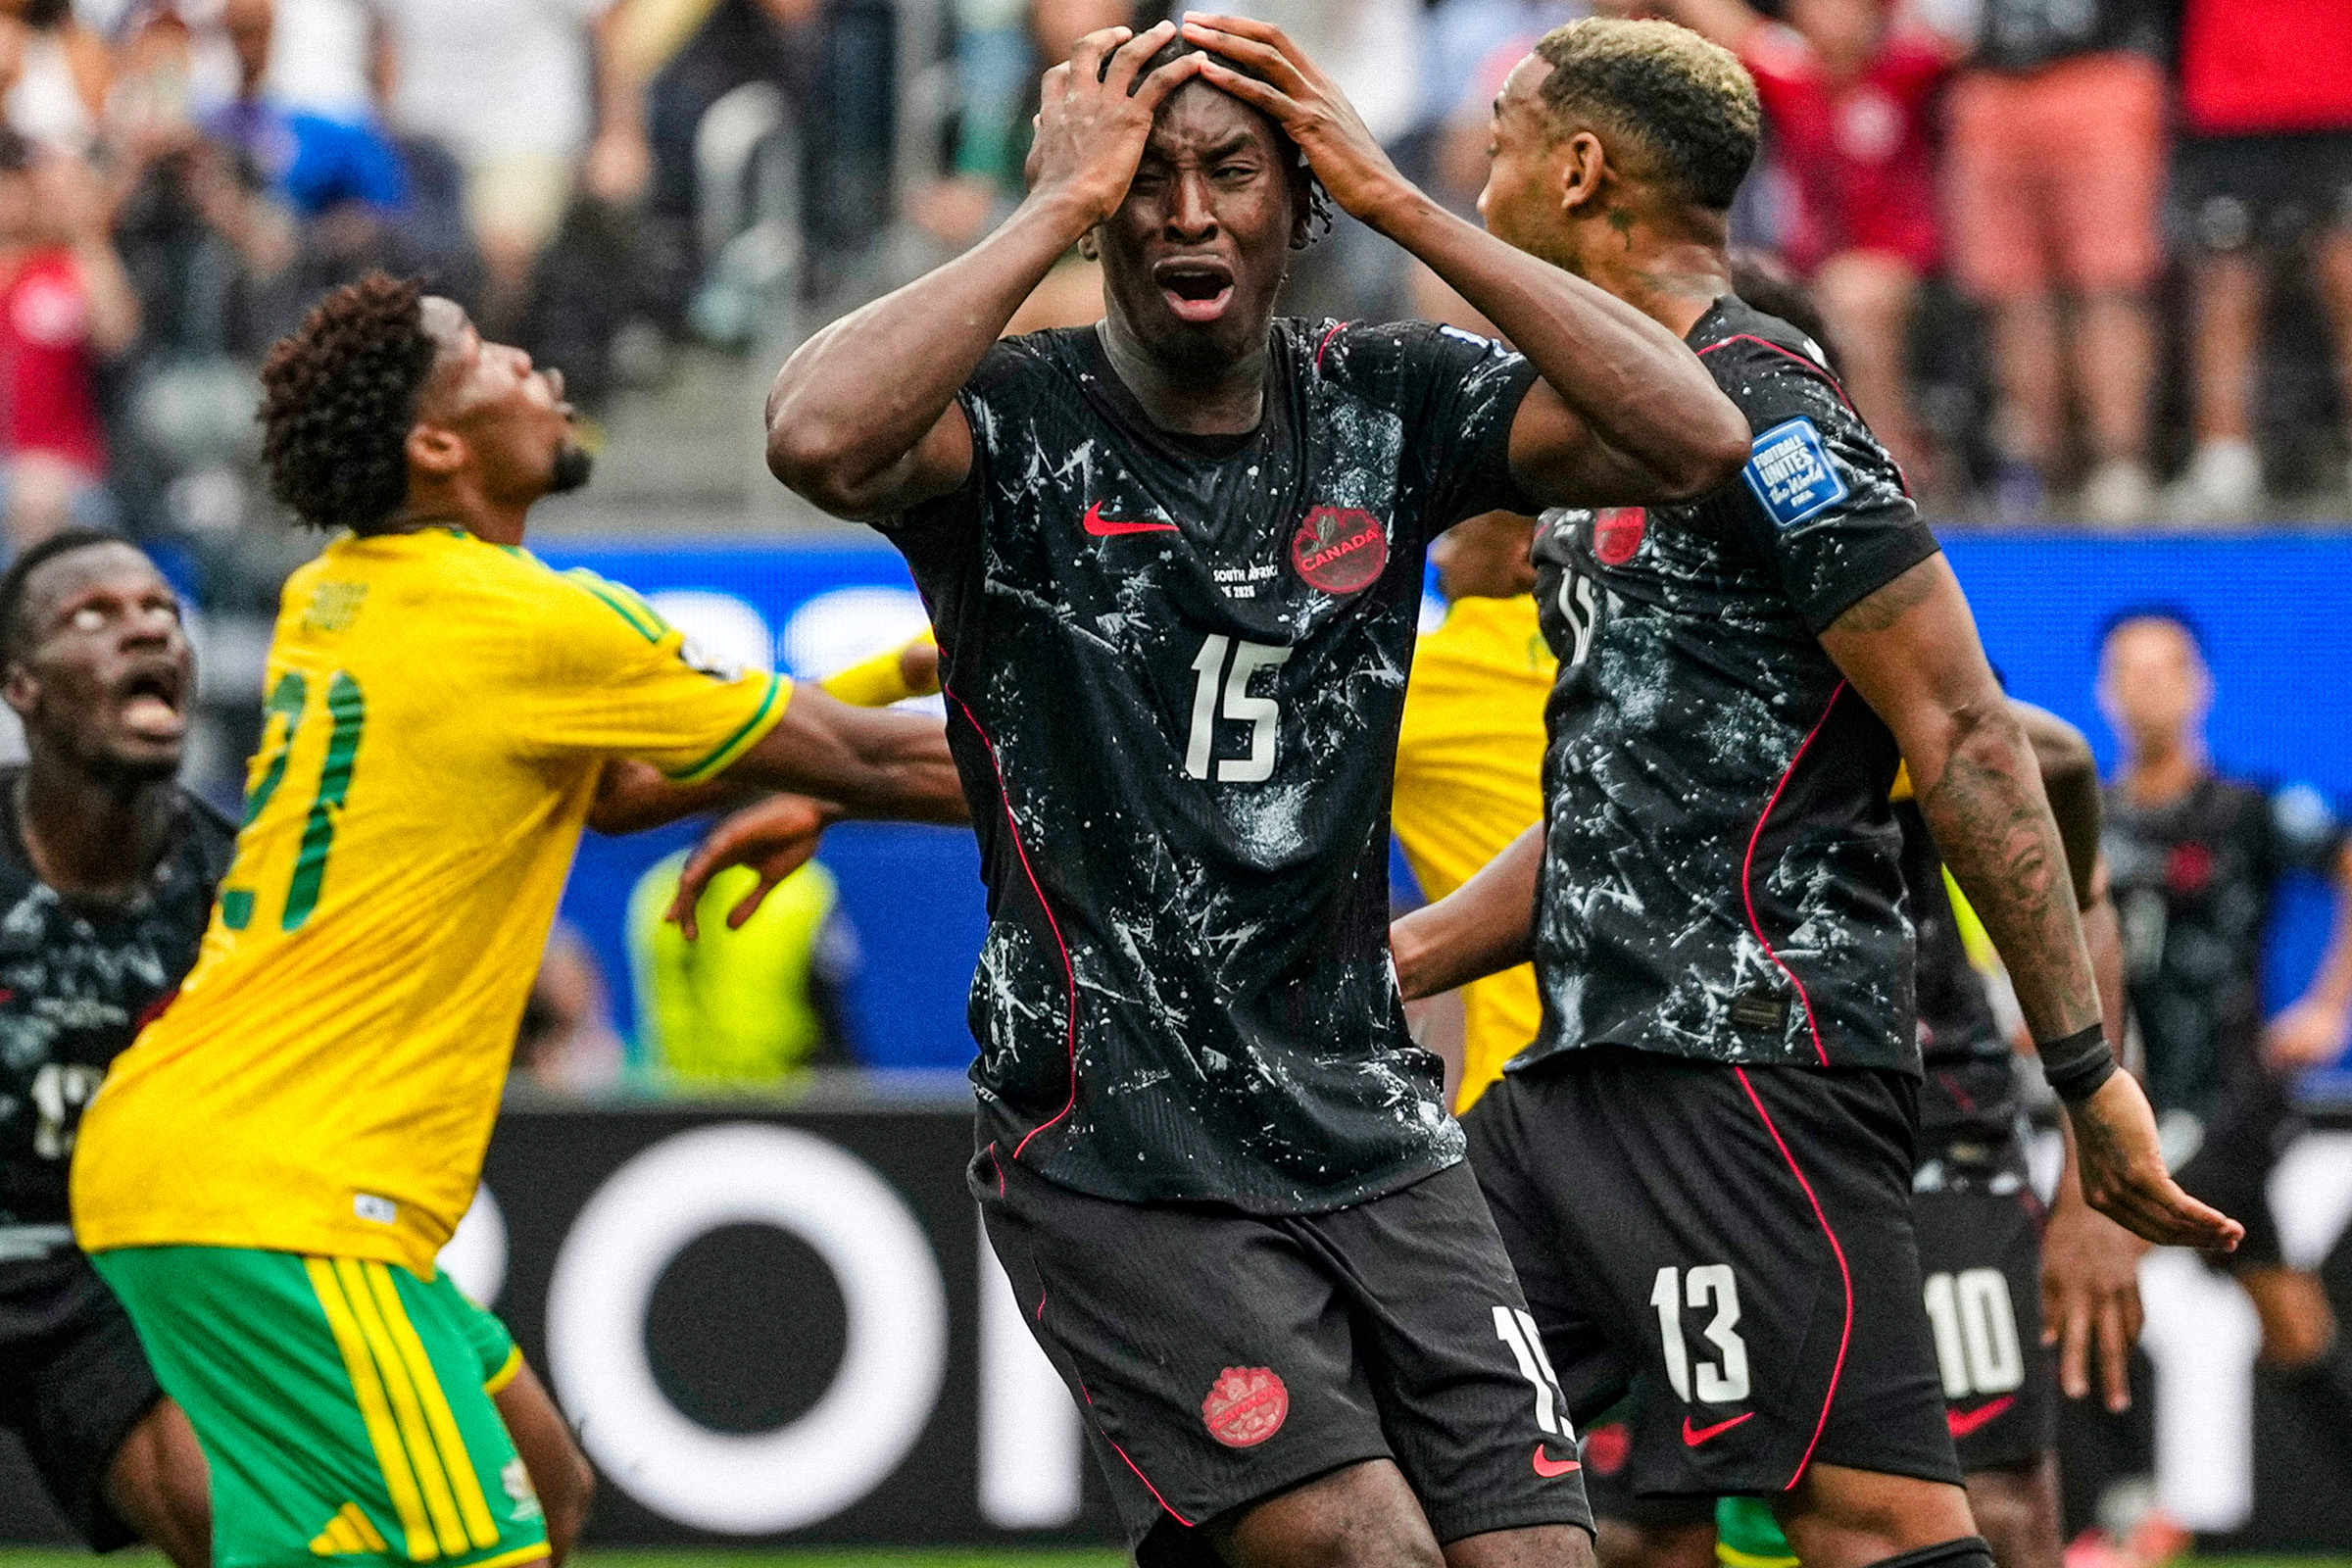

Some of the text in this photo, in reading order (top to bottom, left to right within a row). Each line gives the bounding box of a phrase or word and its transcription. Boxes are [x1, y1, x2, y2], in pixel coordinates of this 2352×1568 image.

[1759, 446, 1815, 488] UNITES
[1213, 567, 1246, 583] SOUTH
[1300, 527, 1380, 571] CANADA
[1185, 633, 1295, 782] 15
[1650, 1263, 1750, 1402] 13
[1924, 1268, 2025, 1398] 10
